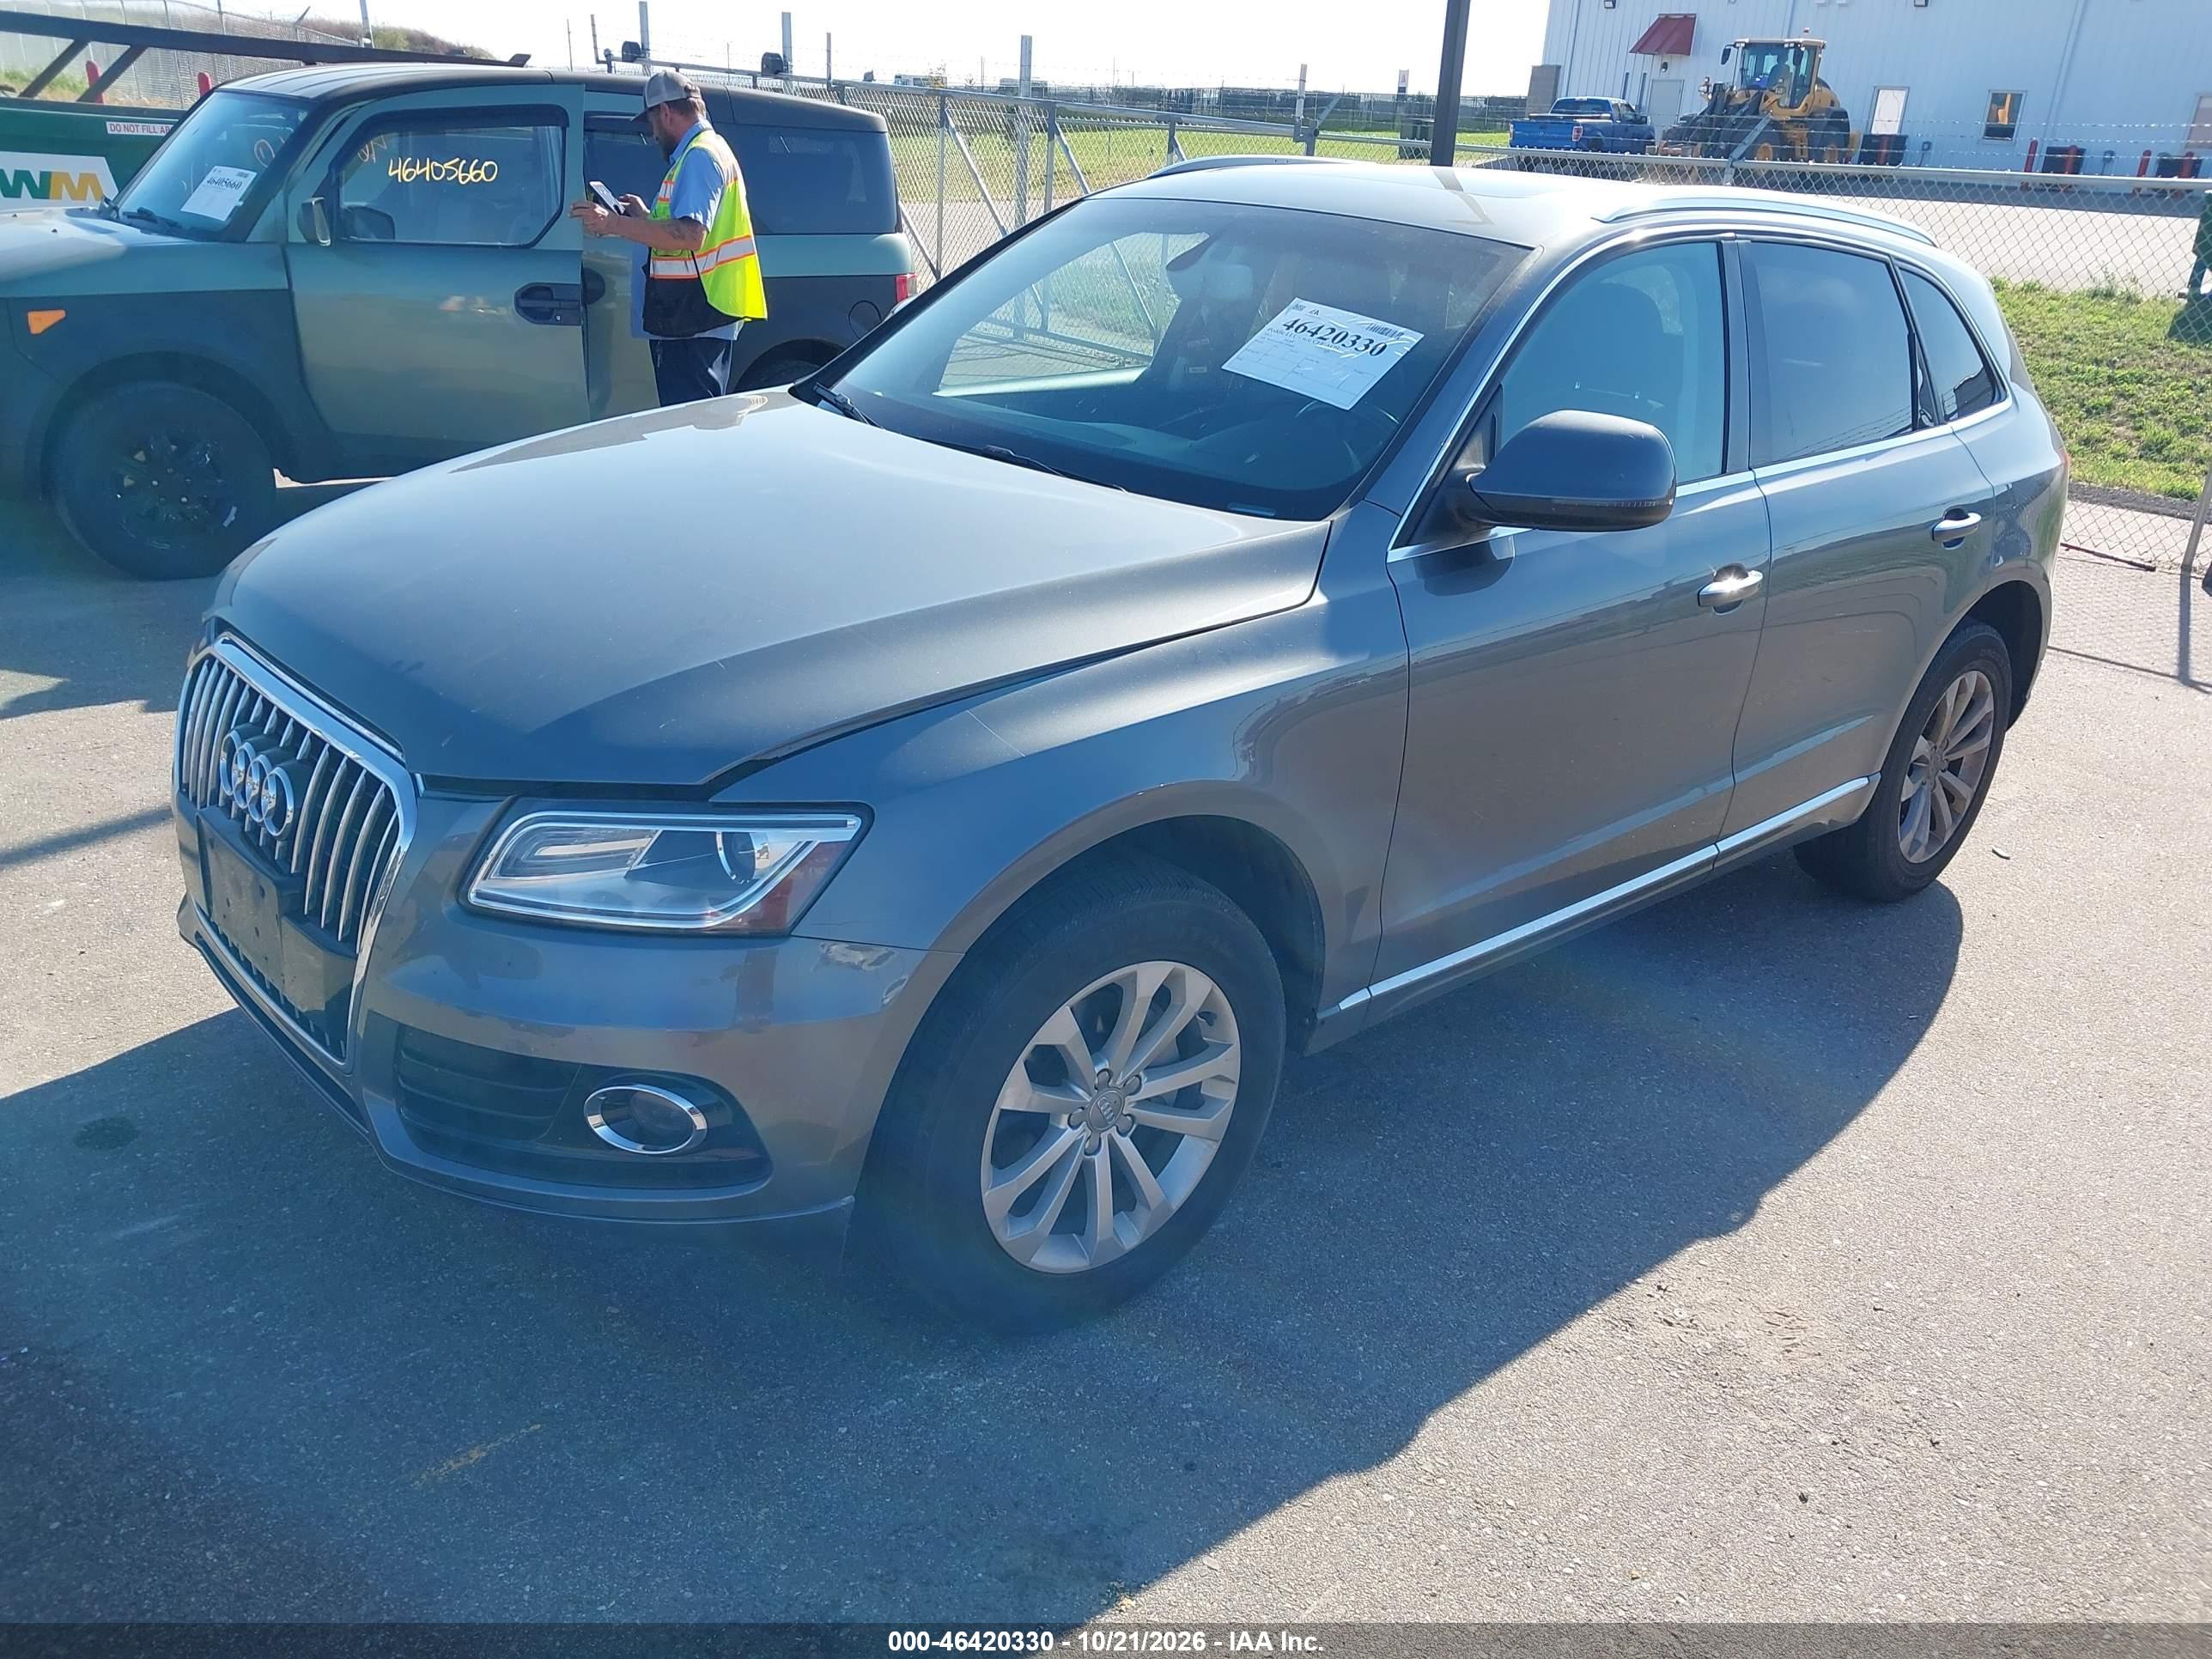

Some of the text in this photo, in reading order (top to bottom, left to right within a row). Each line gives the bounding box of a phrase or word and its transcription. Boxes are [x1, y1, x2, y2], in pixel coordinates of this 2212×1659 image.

[109, 123, 121, 132] DO
[123, 124, 139, 133] NOT
[142, 125, 158, 134] FILL
[388, 157, 498, 185] 46405660
[1282, 319, 1388, 356] 46420330
